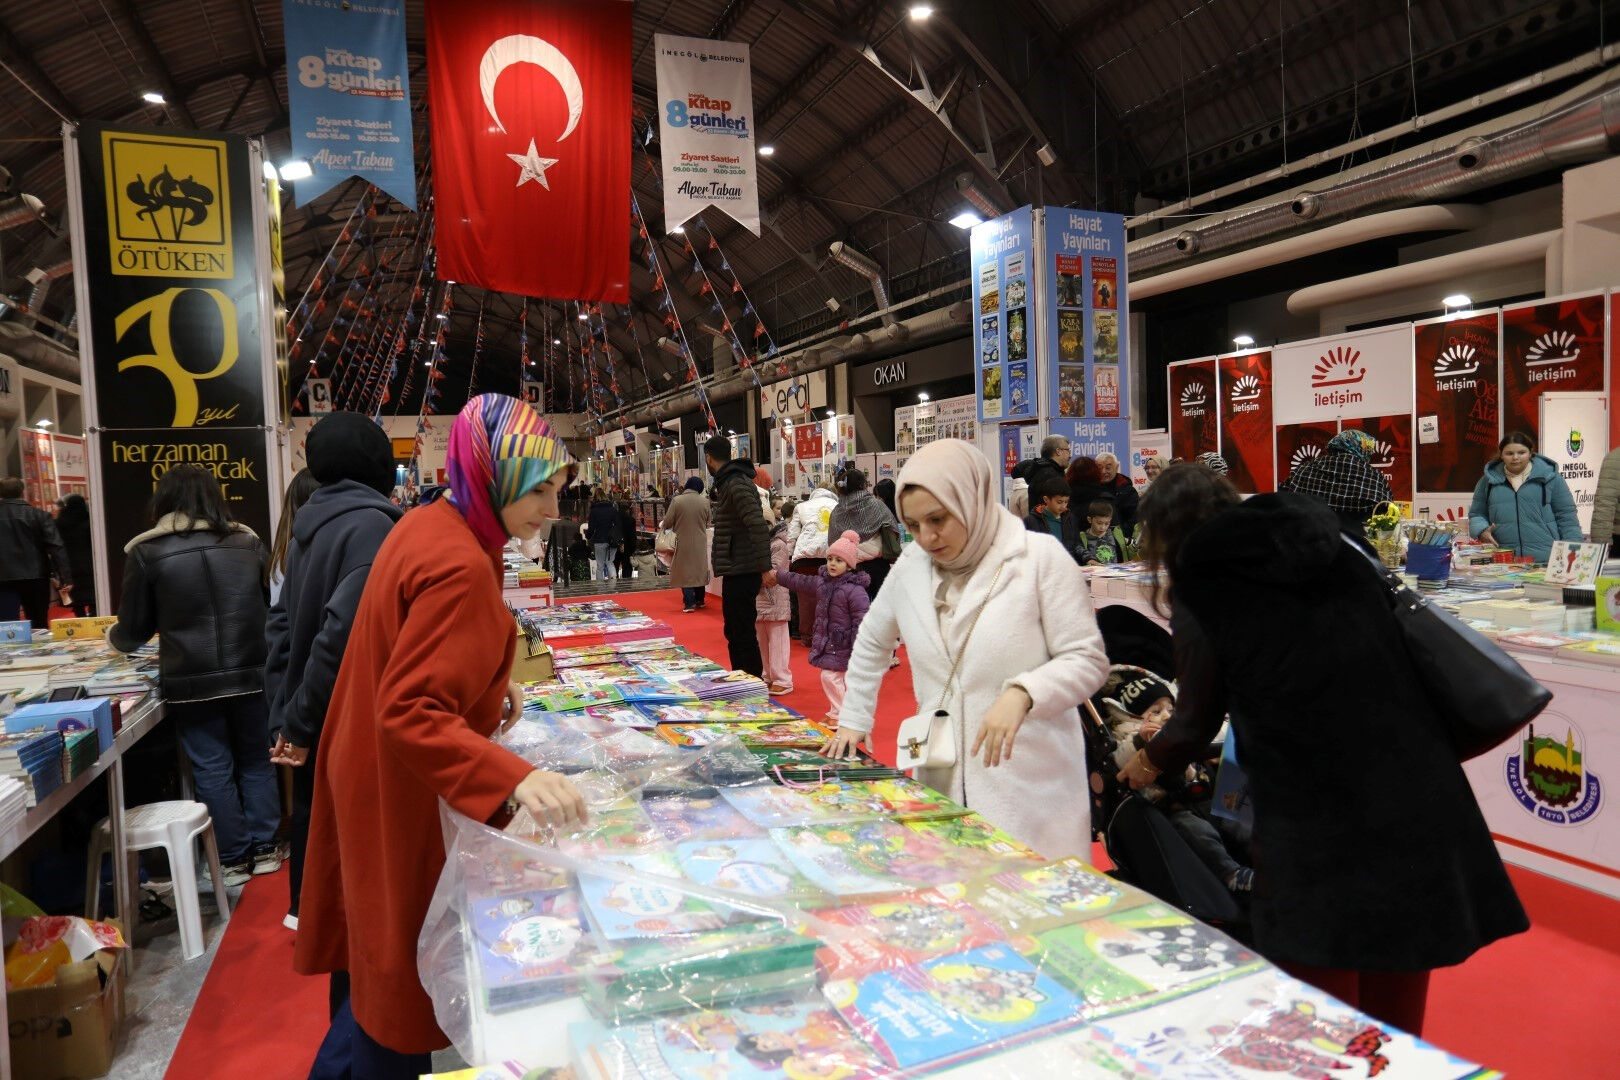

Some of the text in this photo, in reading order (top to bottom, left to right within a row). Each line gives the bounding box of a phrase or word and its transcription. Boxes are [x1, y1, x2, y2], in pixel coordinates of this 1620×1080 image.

[326, 50, 382, 72] Kitap
[708, 54, 745, 63] BELEDİYESİ
[297, 55, 327, 88] 8
[327, 72, 401, 92] günleri
[665, 99, 689, 128] 8
[688, 96, 732, 112] Kitap
[315, 116, 393, 129] Ziyaret Saatleri
[689, 113, 746, 130] günleri
[312, 148, 396, 171] Alper Taban
[680, 152, 740, 164] Ziyaret Saatleri
[677, 180, 743, 199] Alper Taban
[1069, 213, 1103, 235] Hayat
[1062, 232, 1111, 254] Yayınları
[117, 244, 227, 273] ÖTÜKEN
[873, 361, 906, 386] OKAN
[1528, 366, 1577, 384] iletişim
[1436, 377, 1477, 392] iletişim
[1233, 401, 1260, 413] iletişim
[1314, 389, 1363, 409] iletişim
[1181, 407, 1205, 418] iletişim
[1074, 421, 1107, 441] Hayat
[112, 440, 228, 463] her zaman
[1132, 452, 1141, 467] 8
[1560, 470, 1594, 479] ELEDİYESİ
[1569, 782, 1598, 820] BELEDİYESİ
[1540, 809, 1563, 820] 1870
